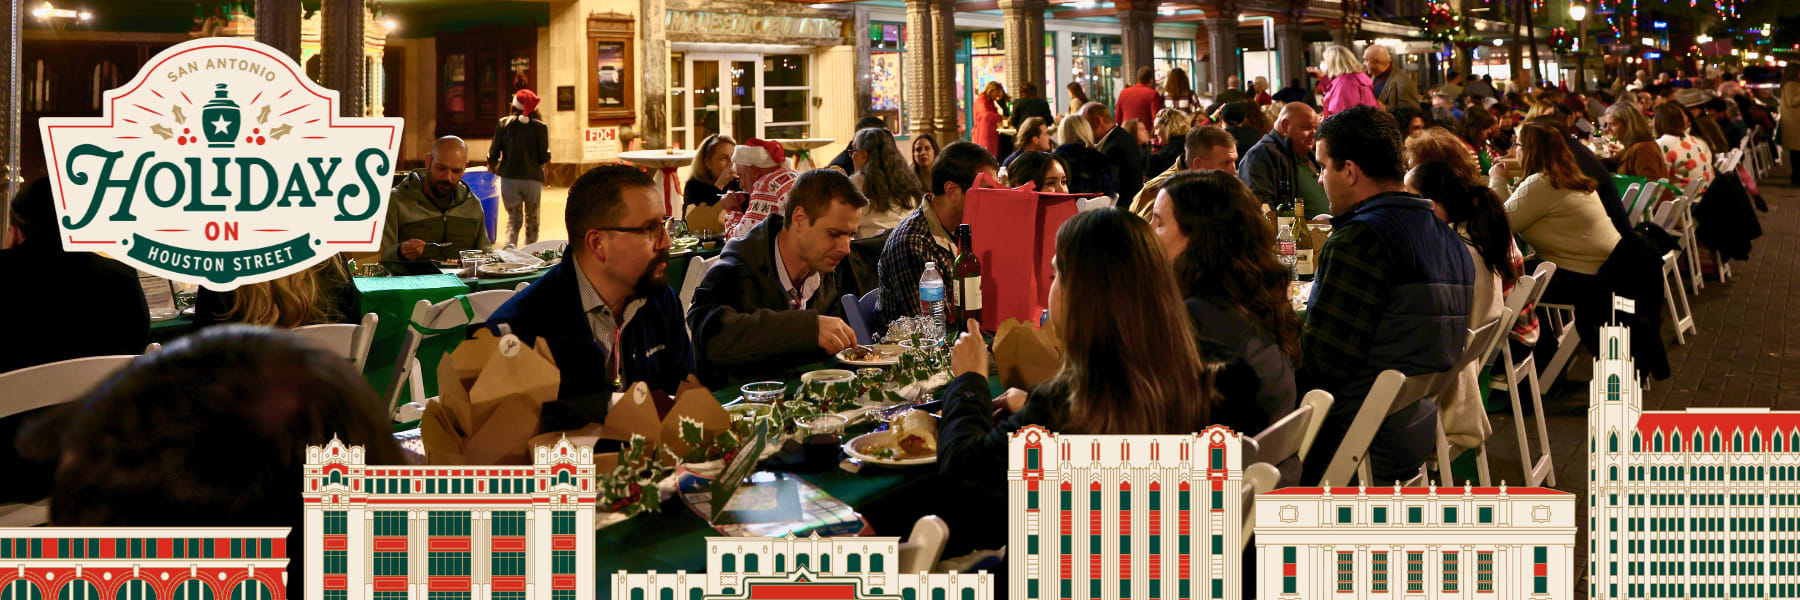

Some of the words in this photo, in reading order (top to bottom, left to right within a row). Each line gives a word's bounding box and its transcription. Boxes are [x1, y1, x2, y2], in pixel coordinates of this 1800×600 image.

[671, 12, 764, 34] MAJESTIC
[767, 16, 842, 38] BUILDING
[590, 129, 611, 141] FDC
